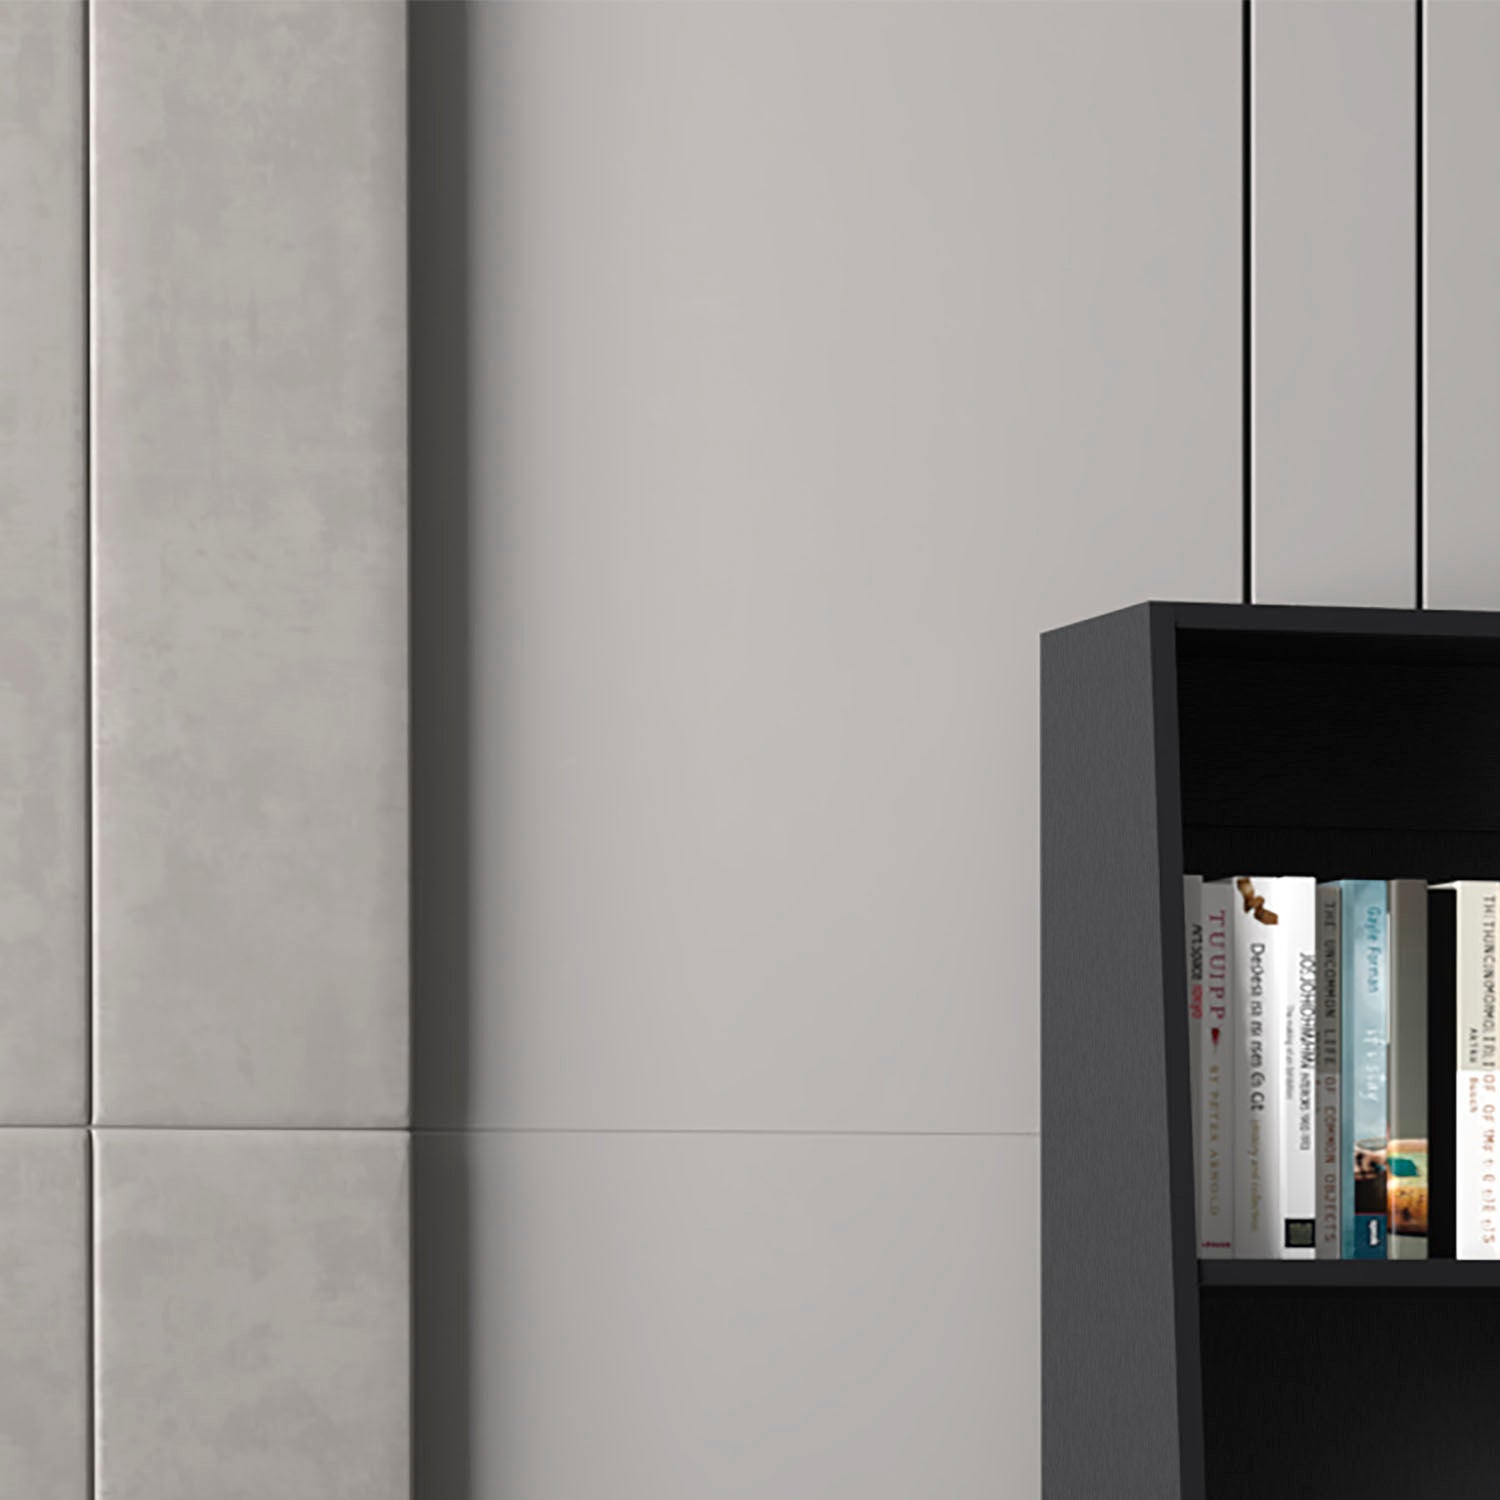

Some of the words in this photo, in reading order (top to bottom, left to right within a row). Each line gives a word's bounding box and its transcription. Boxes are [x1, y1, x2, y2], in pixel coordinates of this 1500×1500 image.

[1364, 906, 1382, 941] Gayle
[1323, 939, 1337, 1017] UNCOMMON
[1368, 946, 1382, 993] Forman
[1323, 1028, 1337, 1064] LIFE
[1323, 1076, 1337, 1093] OF
[1323, 1106, 1337, 1163] COMMON
[1323, 1174, 1337, 1243] OBJECTS
